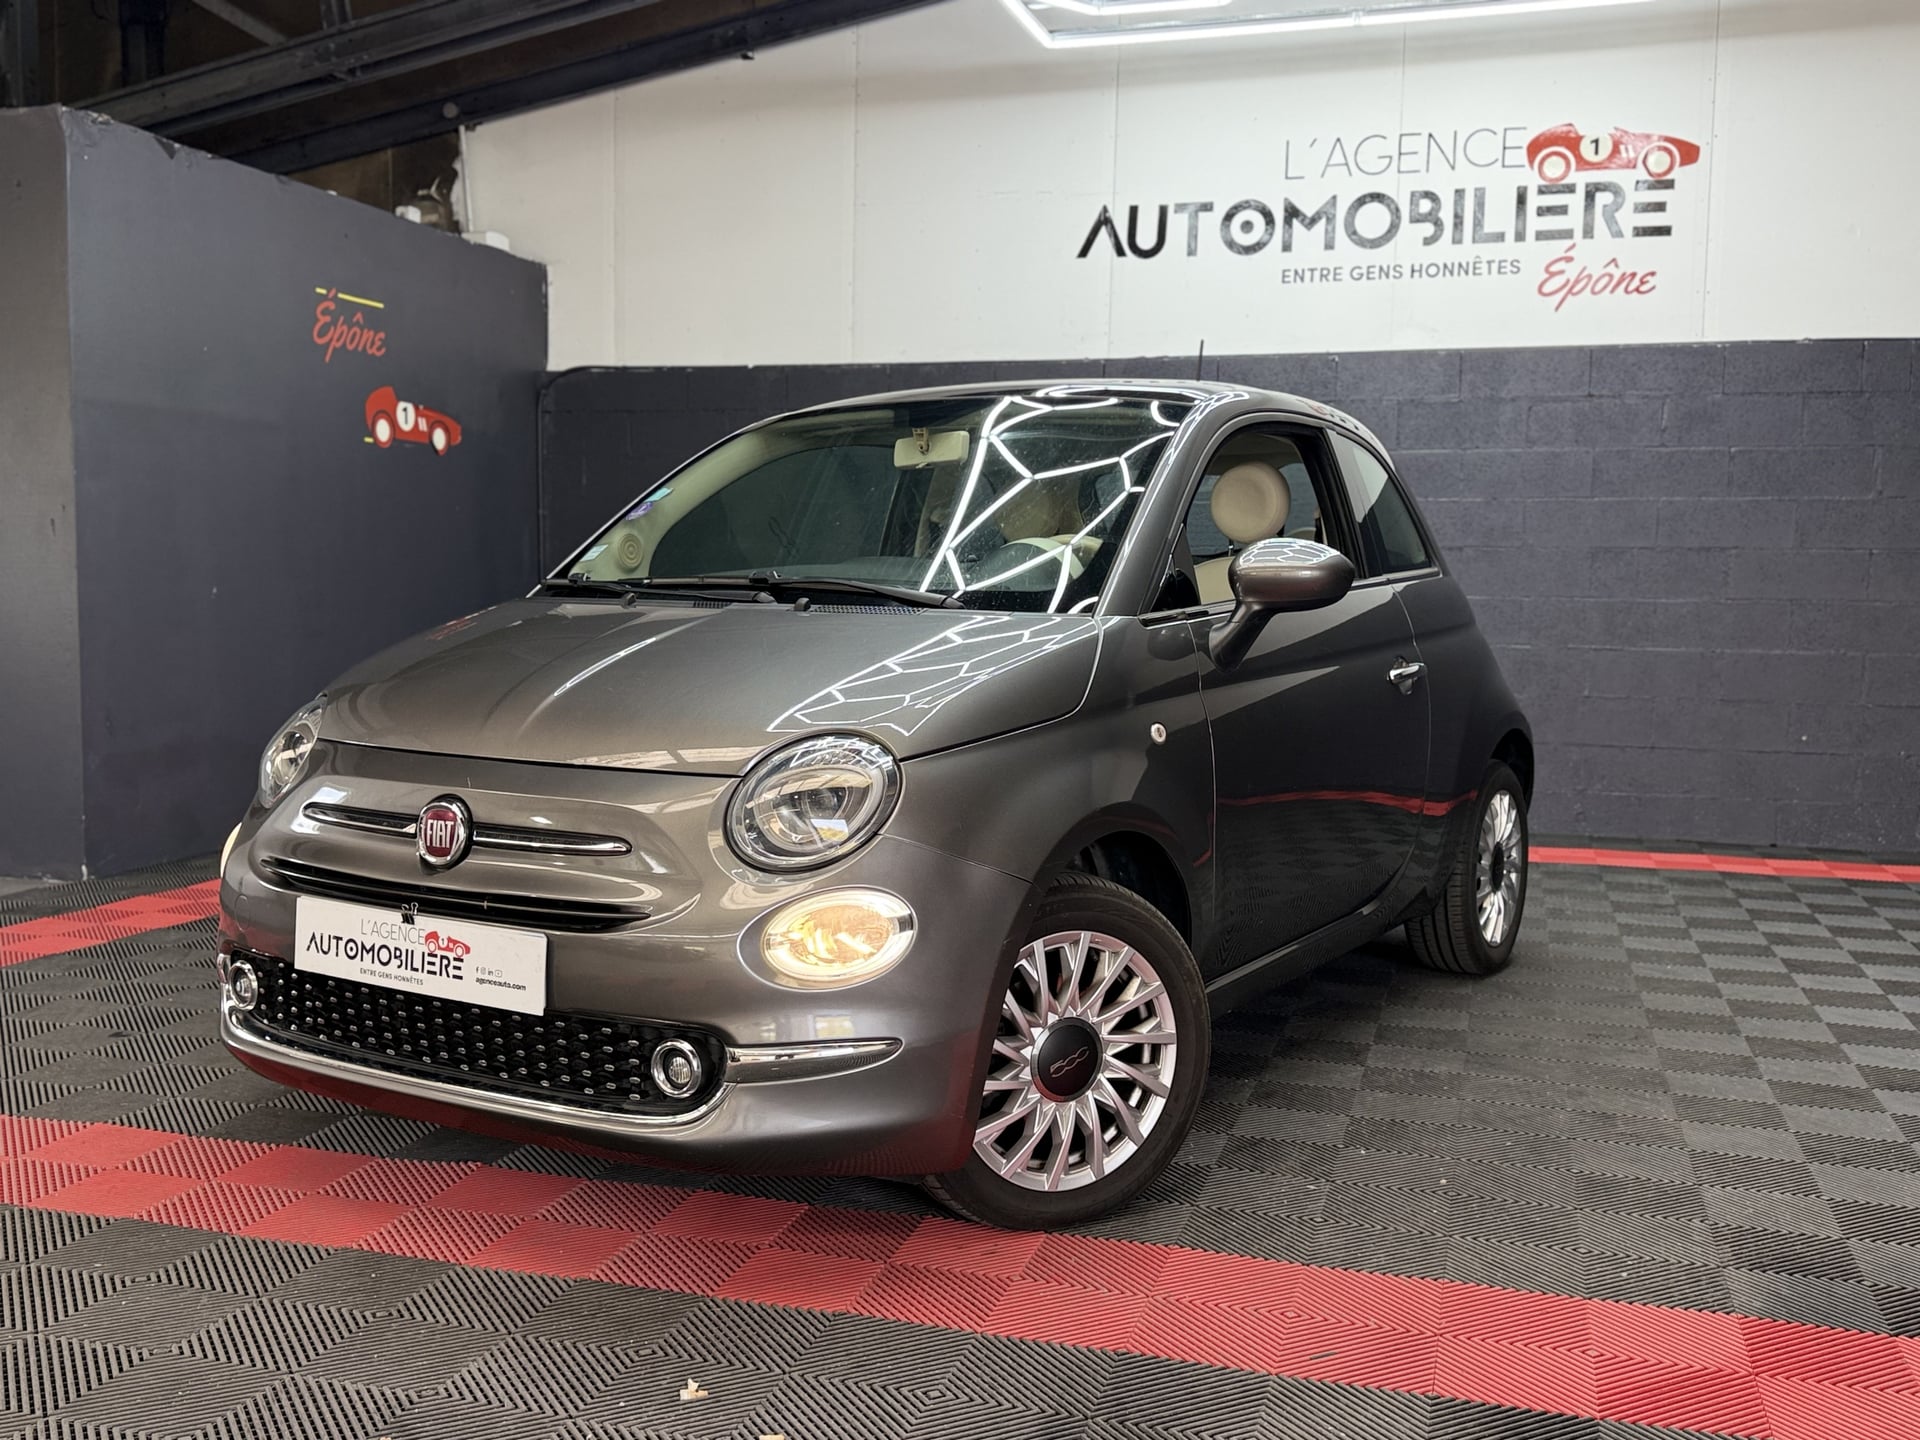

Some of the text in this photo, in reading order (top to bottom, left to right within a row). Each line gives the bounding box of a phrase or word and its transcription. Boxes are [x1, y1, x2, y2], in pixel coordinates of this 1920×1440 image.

[1589, 136, 1600, 156] 1
[1280, 255, 1522, 284] ENTRE GENS HONNÊTES
[1537, 242, 1657, 312] Épône
[312, 287, 387, 363] Épône
[401, 405, 409, 425] 1
[426, 819, 455, 849] FIAT
[359, 967, 424, 986] ENTRE GENS HONNÊTES
[1049, 1045, 1090, 1078] 500
